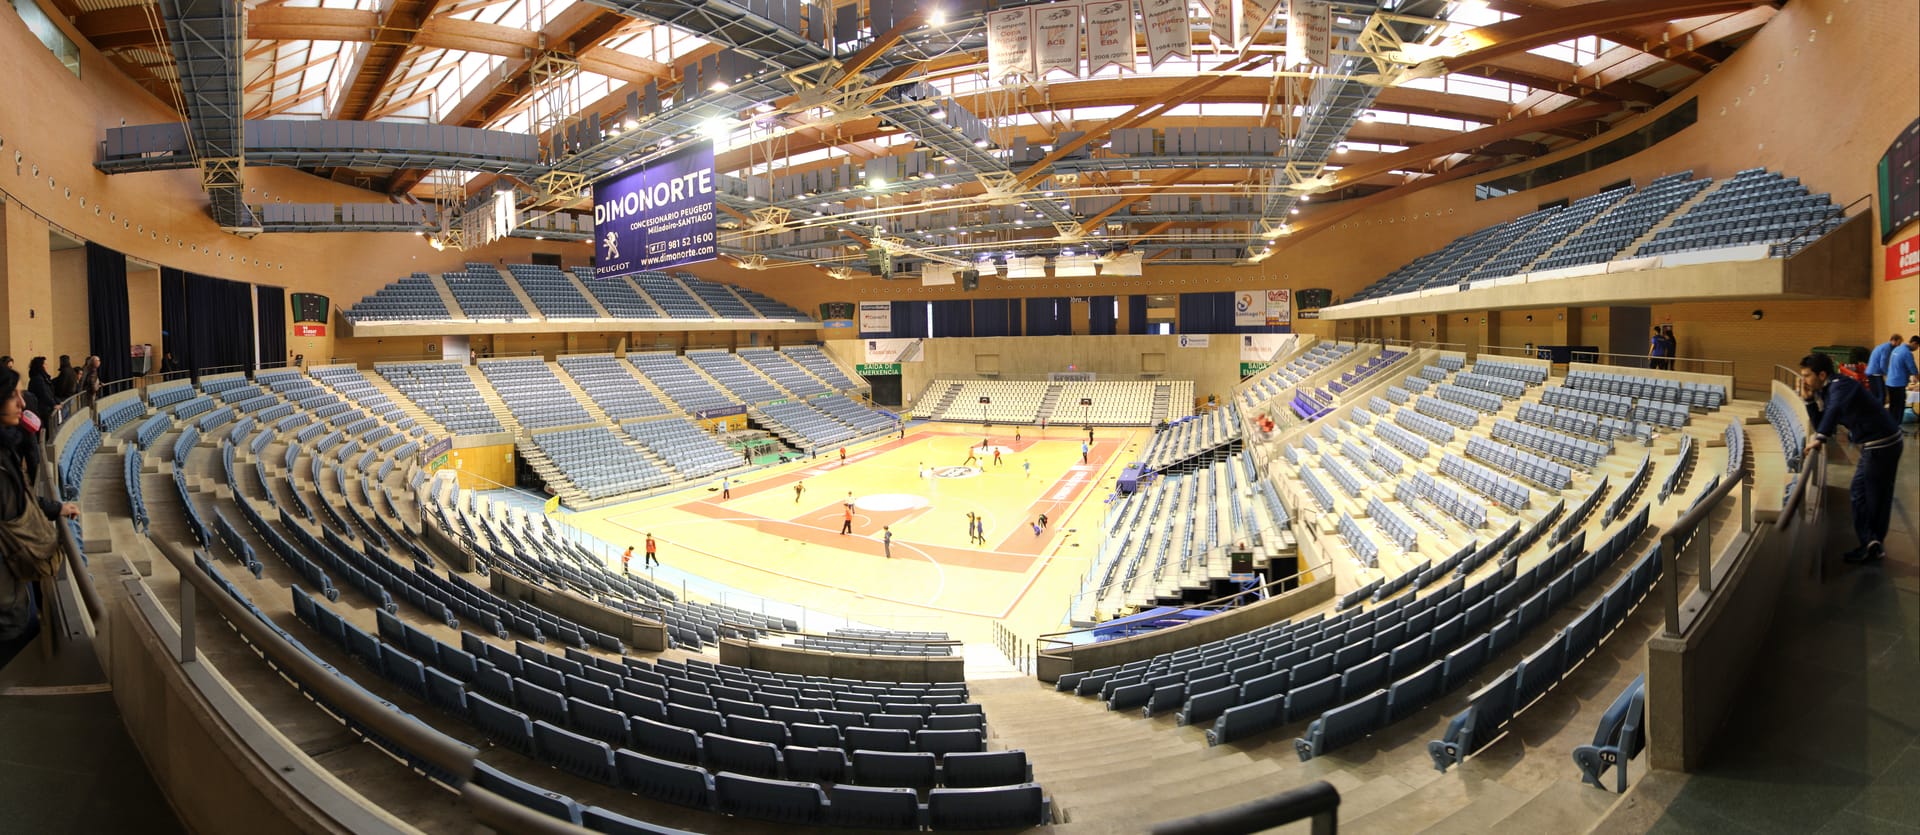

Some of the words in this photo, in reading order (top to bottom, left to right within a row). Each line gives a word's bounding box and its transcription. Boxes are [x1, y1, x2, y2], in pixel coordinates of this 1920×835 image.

[1046, 38, 1066, 46] ACB
[1100, 38, 1119, 46] EBA
[595, 168, 712, 226] DIMONORTE
[630, 211, 680, 231] CONCESIONARIO
[680, 202, 713, 217] PEUGEOT
[647, 212, 713, 235] Milladoiro-SANTIAGO
[668, 240, 680, 250] 981
[682, 237, 691, 247] 52
[693, 235, 702, 245] 16
[702, 232, 713, 243] 00
[640, 245, 714, 266] www.dimonorte.com
[1601, 752, 1616, 762] 10
